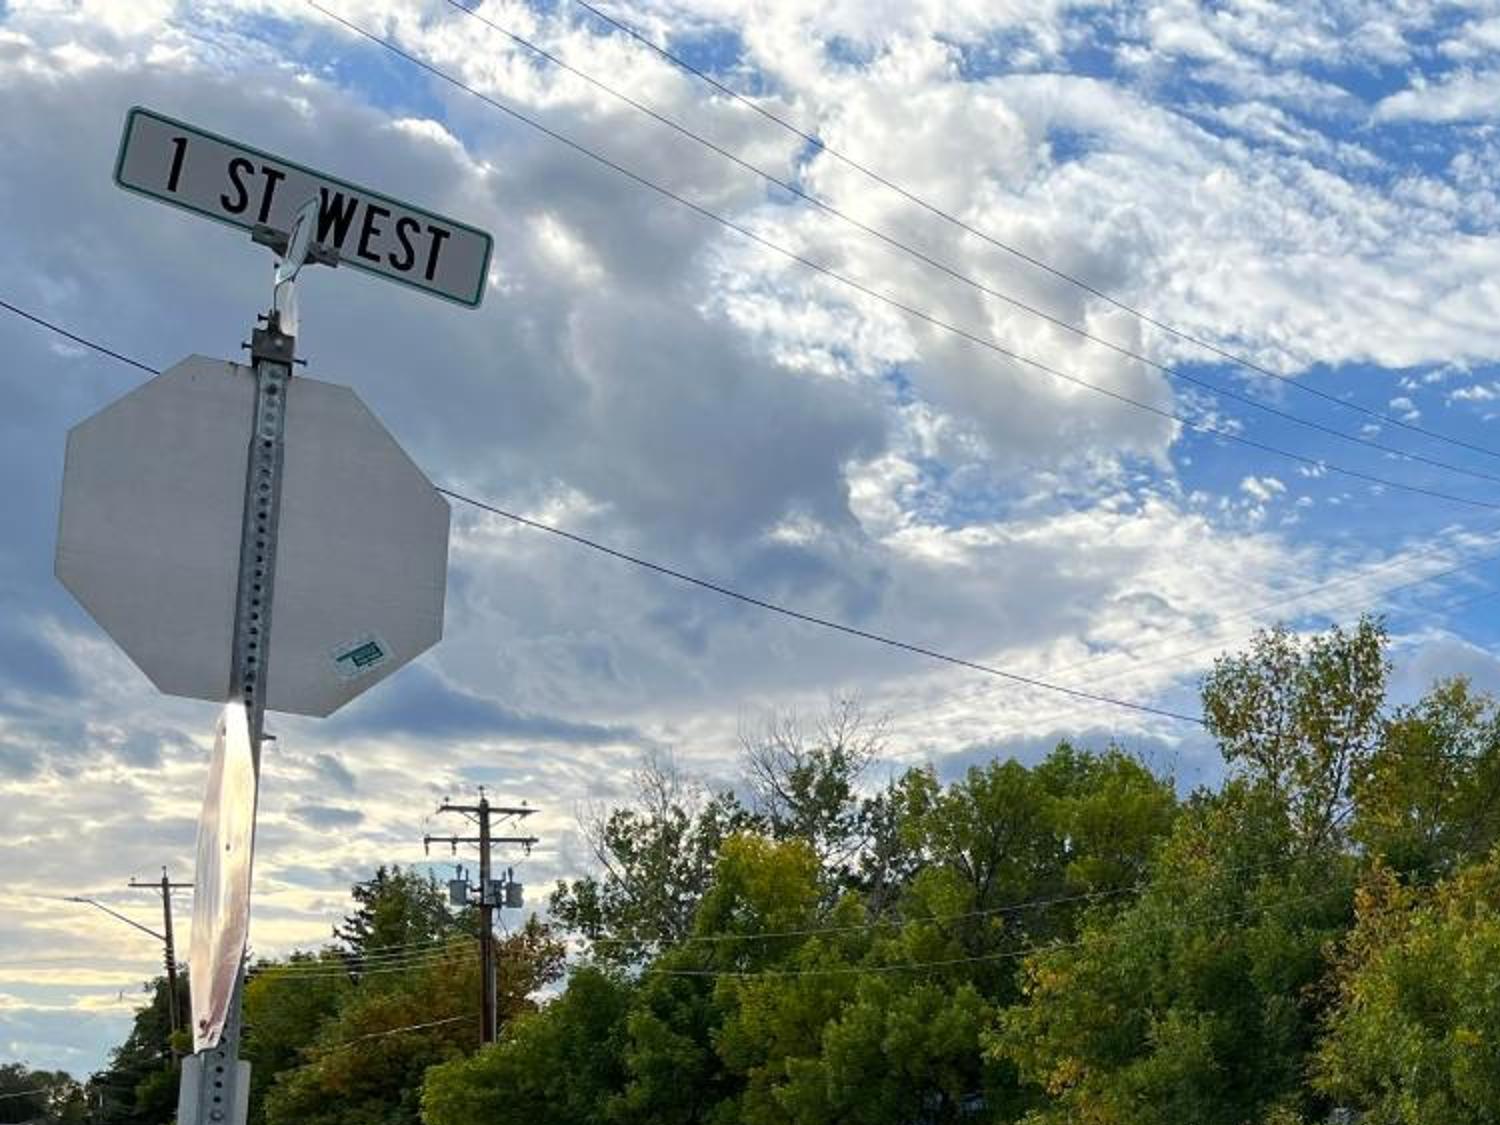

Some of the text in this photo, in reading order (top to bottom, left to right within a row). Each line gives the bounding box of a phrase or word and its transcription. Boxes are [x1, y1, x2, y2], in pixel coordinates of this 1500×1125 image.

[167, 138, 450, 280] 1 ST WEST
